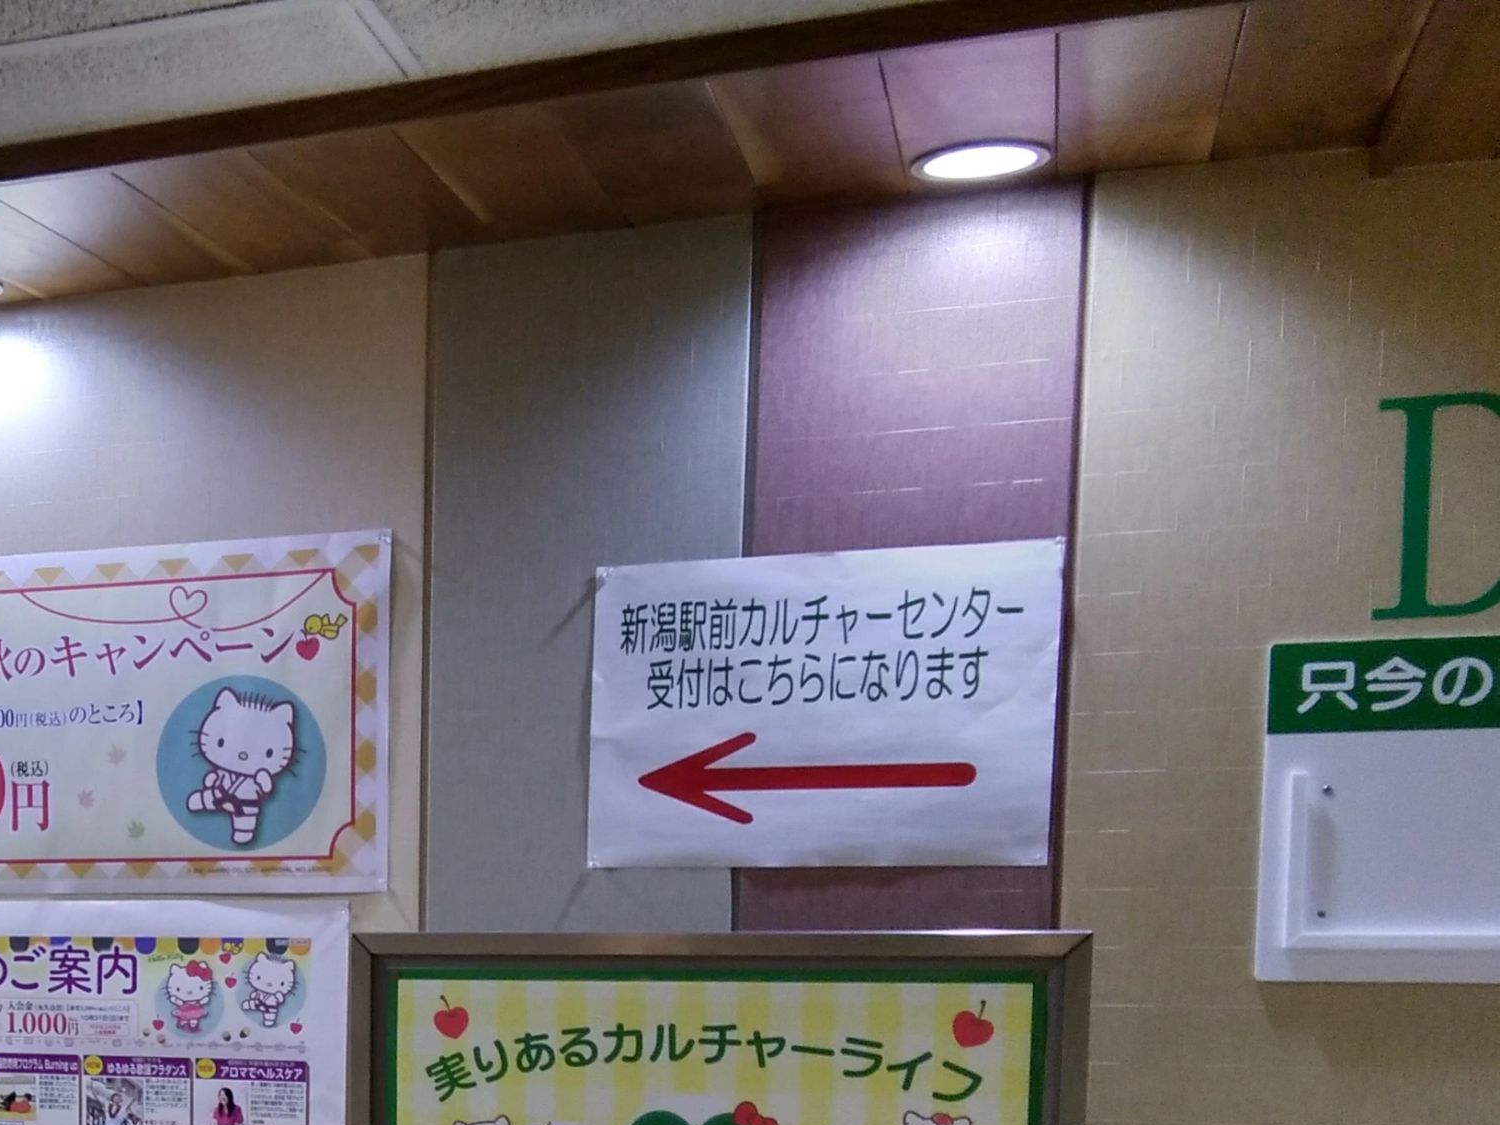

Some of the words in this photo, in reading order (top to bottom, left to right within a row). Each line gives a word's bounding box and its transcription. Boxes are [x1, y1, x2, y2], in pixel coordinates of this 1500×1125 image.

[619, 585, 1025, 658] 新潟駅前カルチャーセンター
[646, 645, 991, 712] 受付はこちらになります
[1297, 656, 1493, 714] 只今の
[426, 1022, 983, 1102] 実りあるカルチャーライフ
